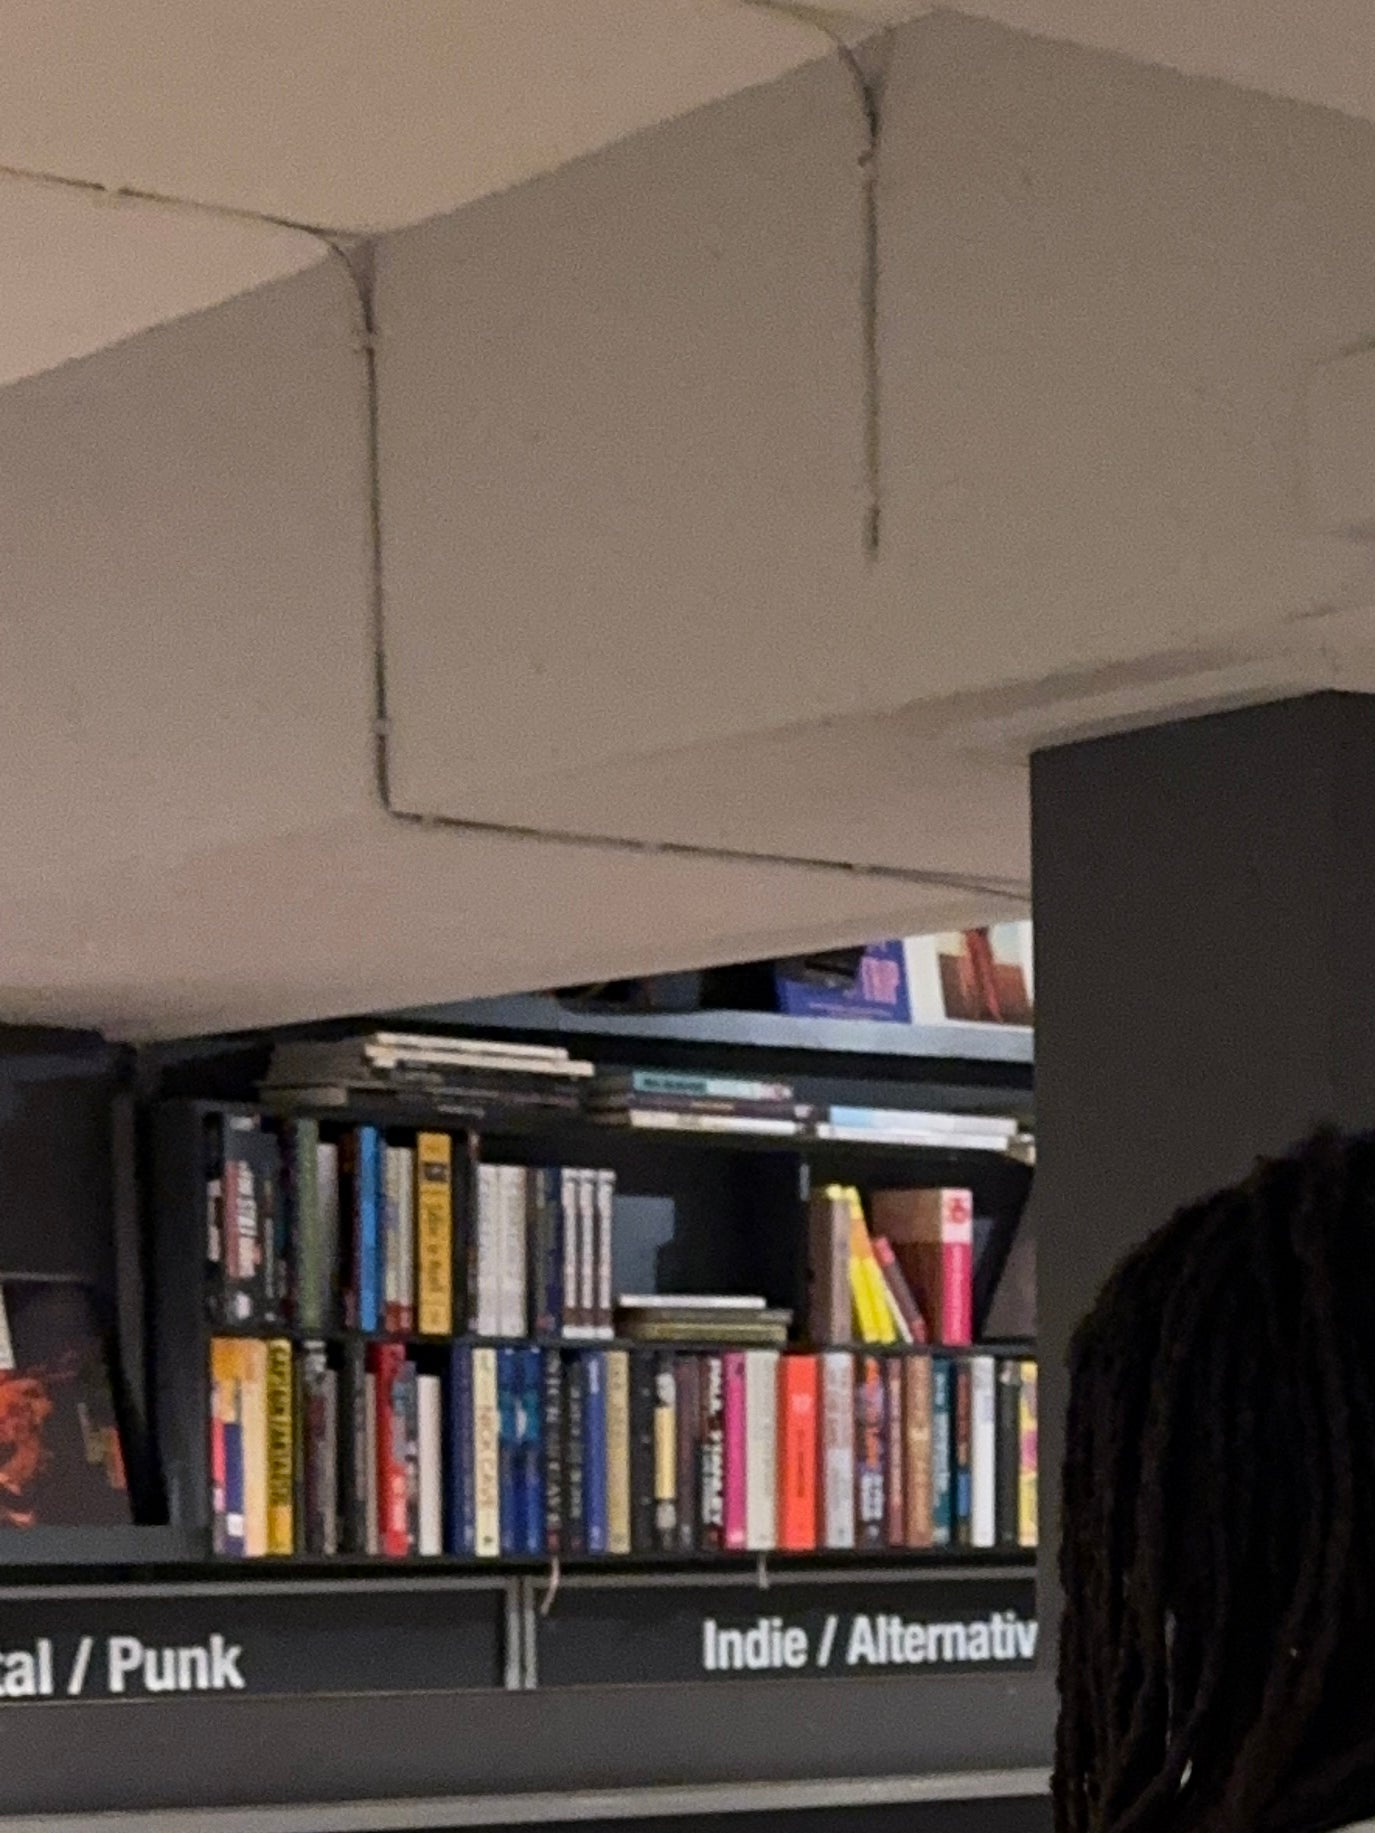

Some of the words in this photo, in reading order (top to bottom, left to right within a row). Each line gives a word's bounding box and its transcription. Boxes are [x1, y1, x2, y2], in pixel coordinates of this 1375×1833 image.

[67, 1635, 94, 1695] /
[108, 1633, 246, 1694] Punk
[703, 1618, 808, 1671] Indie
[817, 1616, 840, 1668] /
